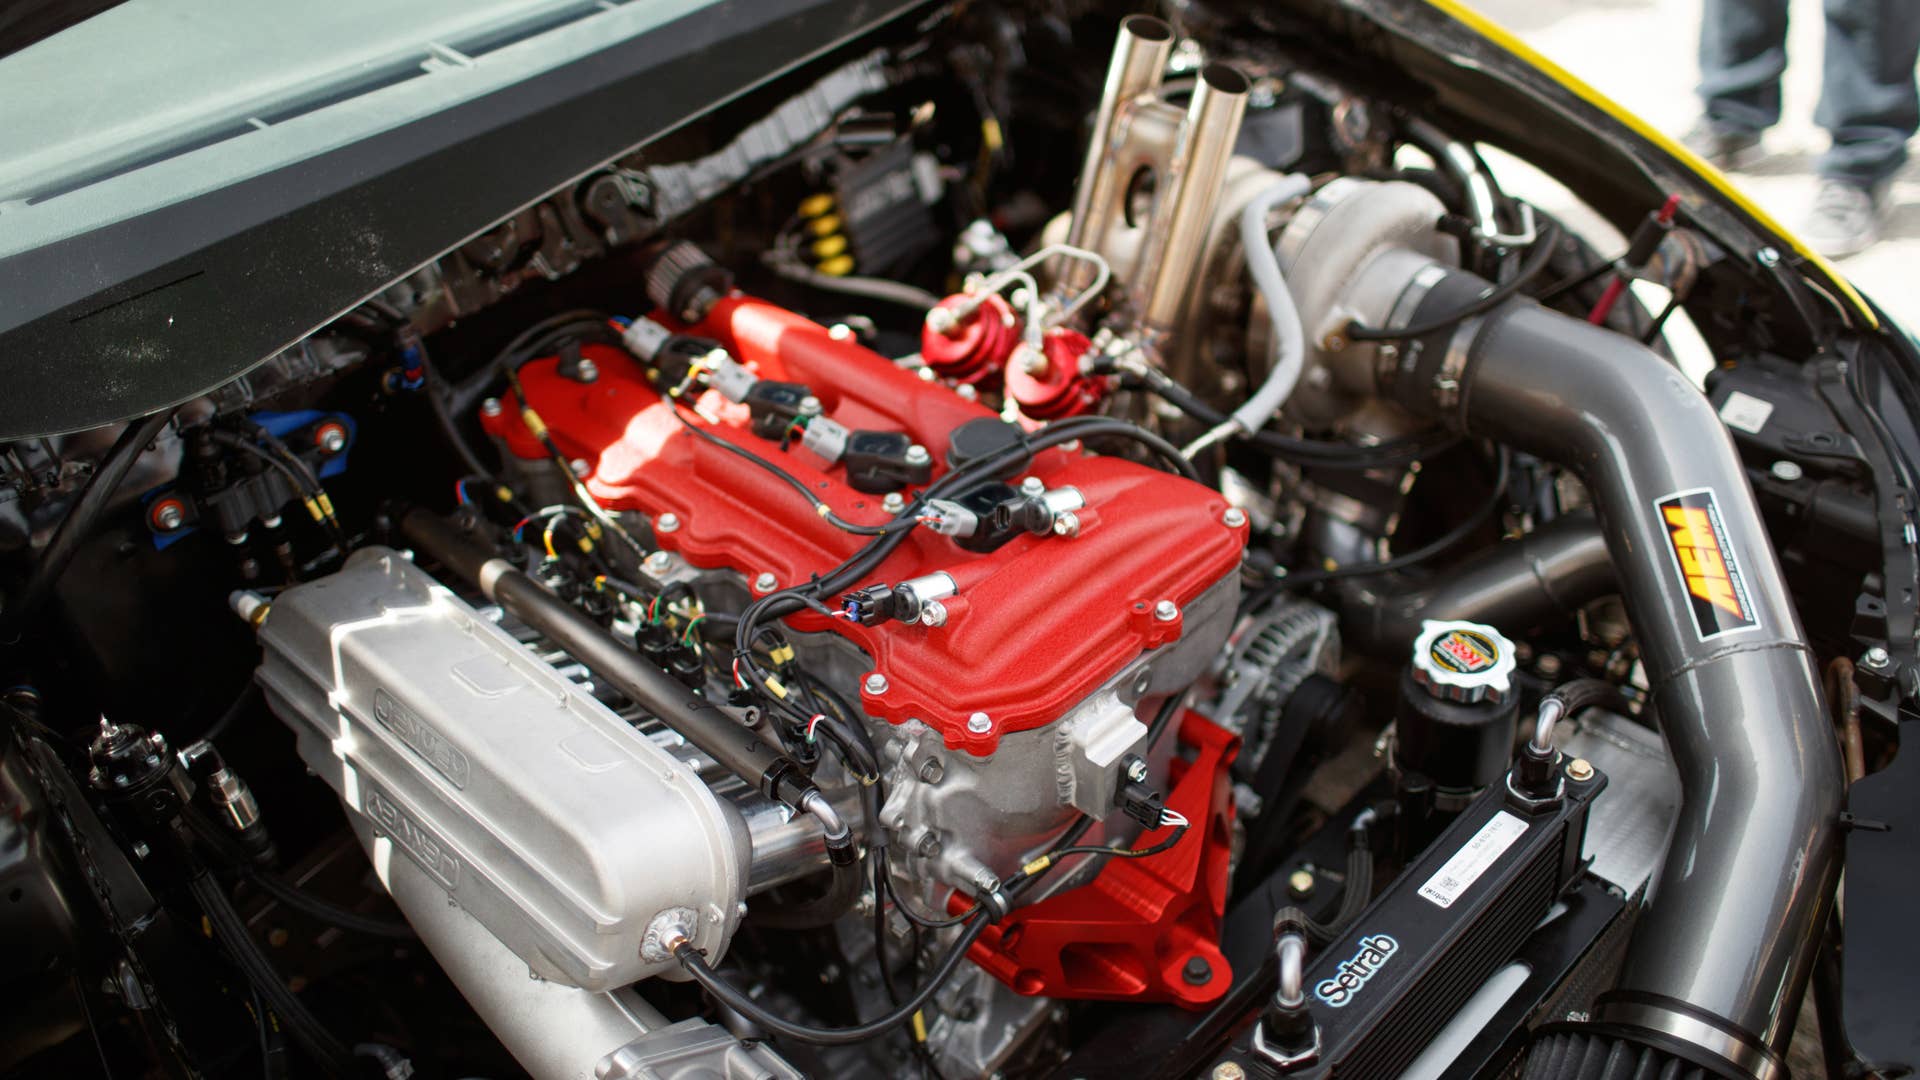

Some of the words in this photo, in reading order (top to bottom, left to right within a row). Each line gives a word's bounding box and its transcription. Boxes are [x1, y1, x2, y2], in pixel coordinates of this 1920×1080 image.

[1661, 505, 1744, 619] AEM
[377, 699, 465, 772] JENVEY
[372, 792, 456, 871] JENVEY
[1317, 935, 1397, 1005] Setrab
